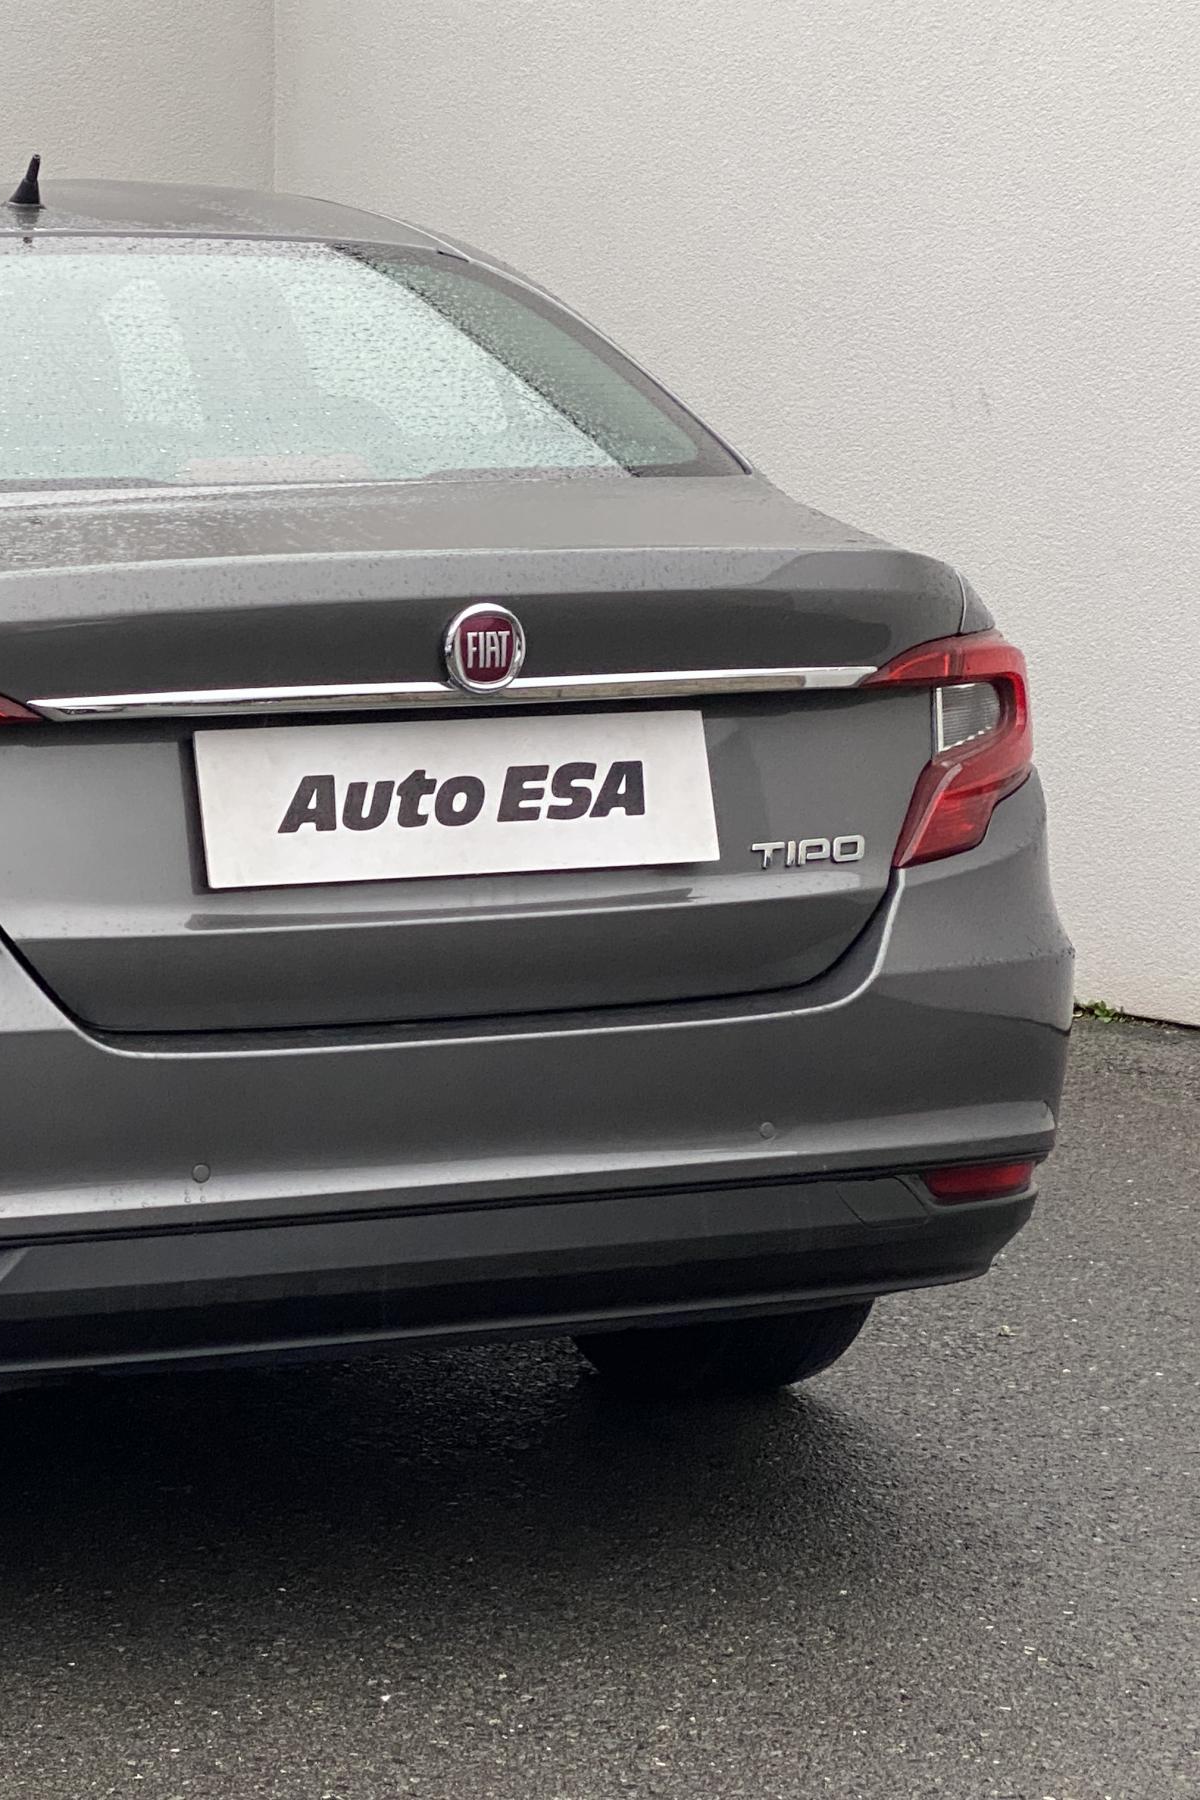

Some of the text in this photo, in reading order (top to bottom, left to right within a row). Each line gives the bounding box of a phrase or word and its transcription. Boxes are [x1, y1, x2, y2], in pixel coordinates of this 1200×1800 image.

[466, 630, 510, 669] FIAT
[278, 760, 645, 834] Auto ESA
[751, 836, 865, 869] TIPO
